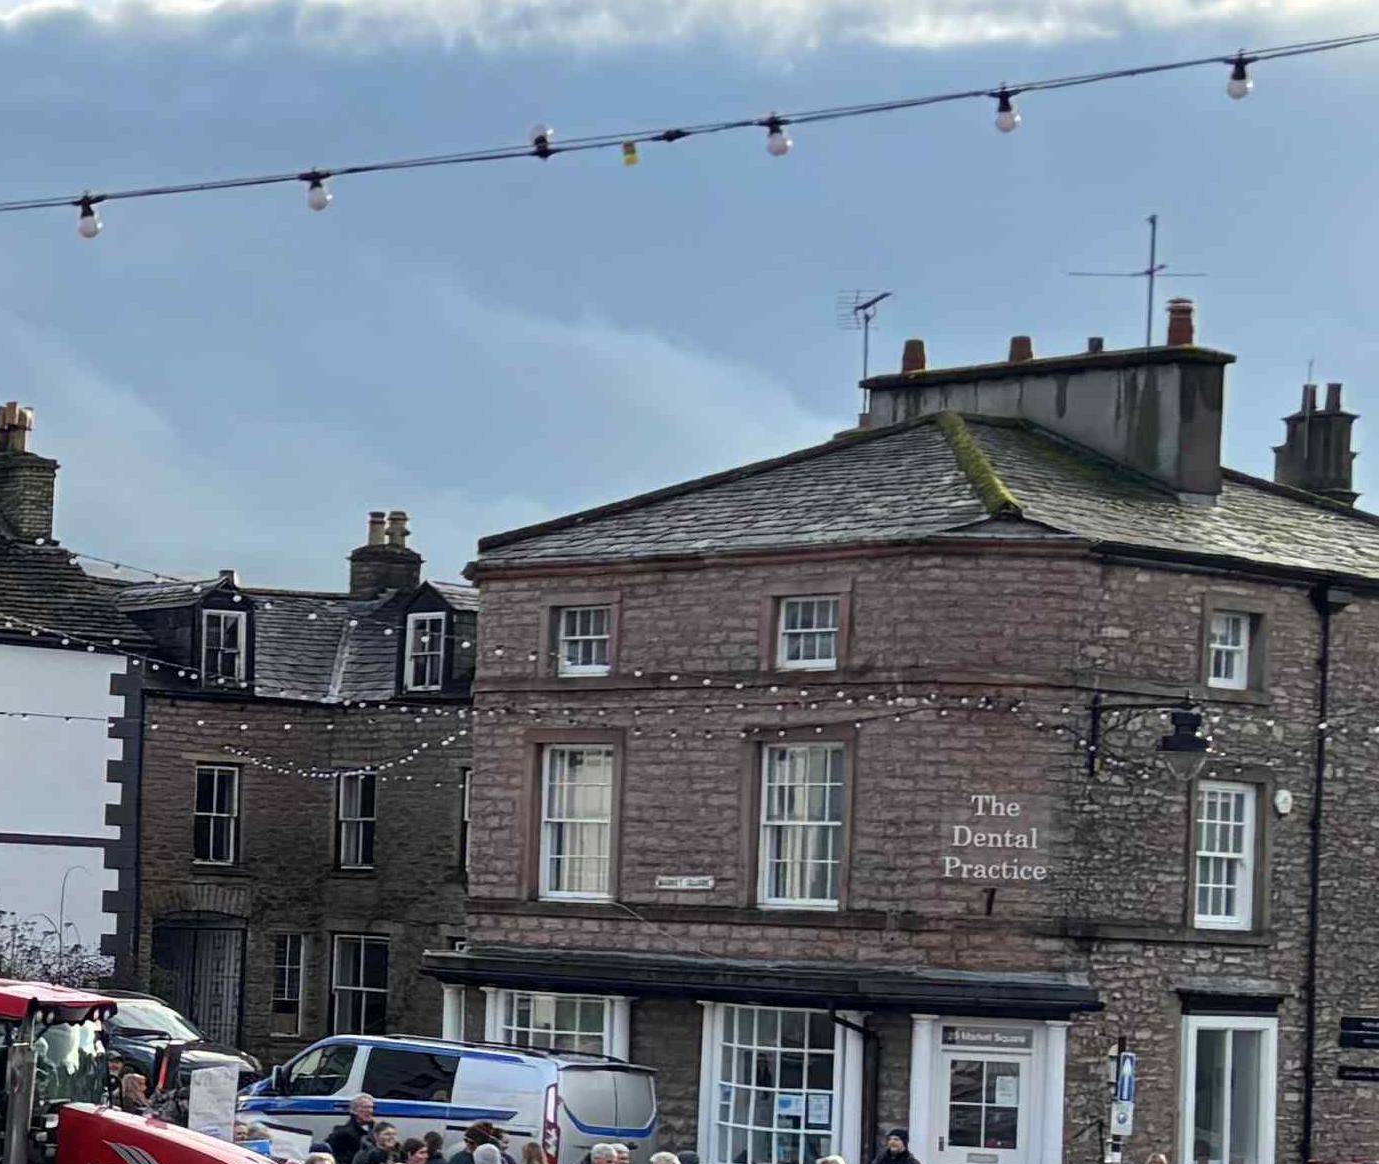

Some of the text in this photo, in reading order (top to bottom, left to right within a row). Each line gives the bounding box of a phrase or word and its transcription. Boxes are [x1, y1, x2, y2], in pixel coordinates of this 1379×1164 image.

[971, 795, 1021, 816] The
[951, 825, 1038, 849] Dental
[943, 856, 1047, 880] Practice
